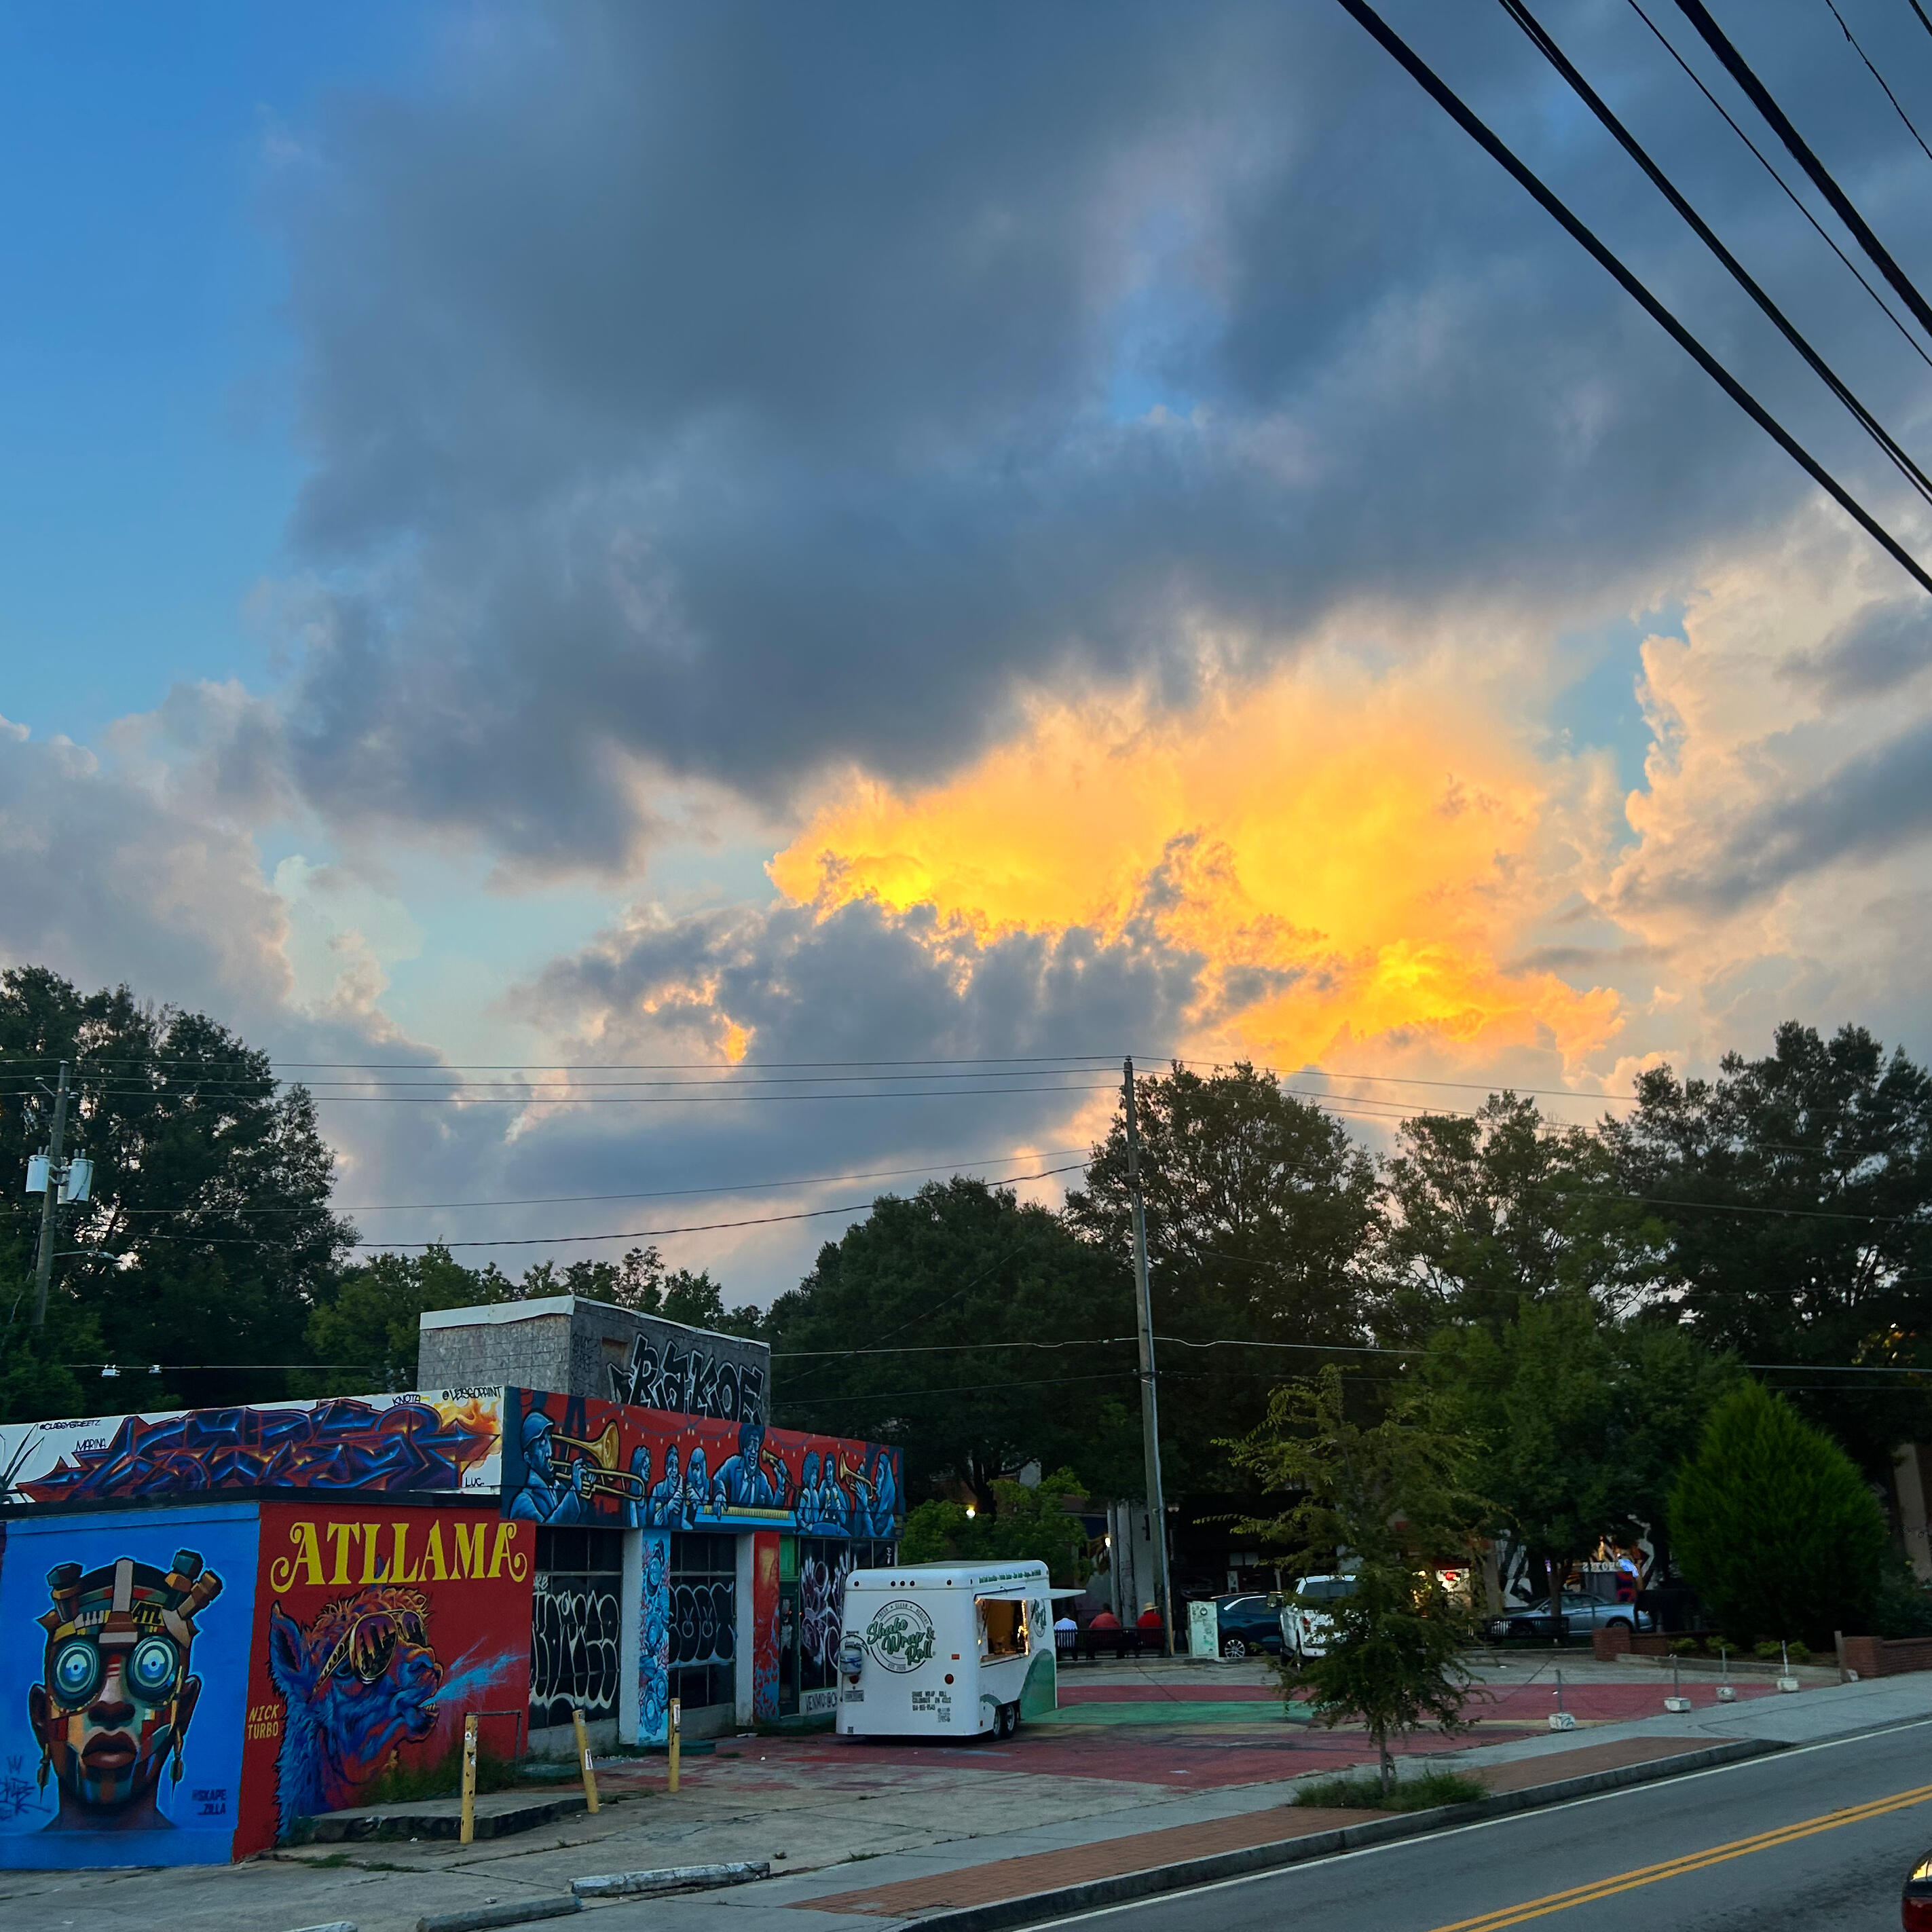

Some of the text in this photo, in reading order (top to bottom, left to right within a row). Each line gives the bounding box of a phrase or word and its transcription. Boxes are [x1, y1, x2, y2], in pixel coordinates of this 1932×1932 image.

[76, 1438, 106, 1451] MARINA
[271, 1519, 527, 1593] ATLLAMA
[866, 1617, 908, 1645] Shake
[881, 1631, 925, 1655] Wrap
[905, 1640, 933, 1666] Roll
[248, 1704, 280, 1722] NICK
[248, 1721, 279, 1740] TURBO
